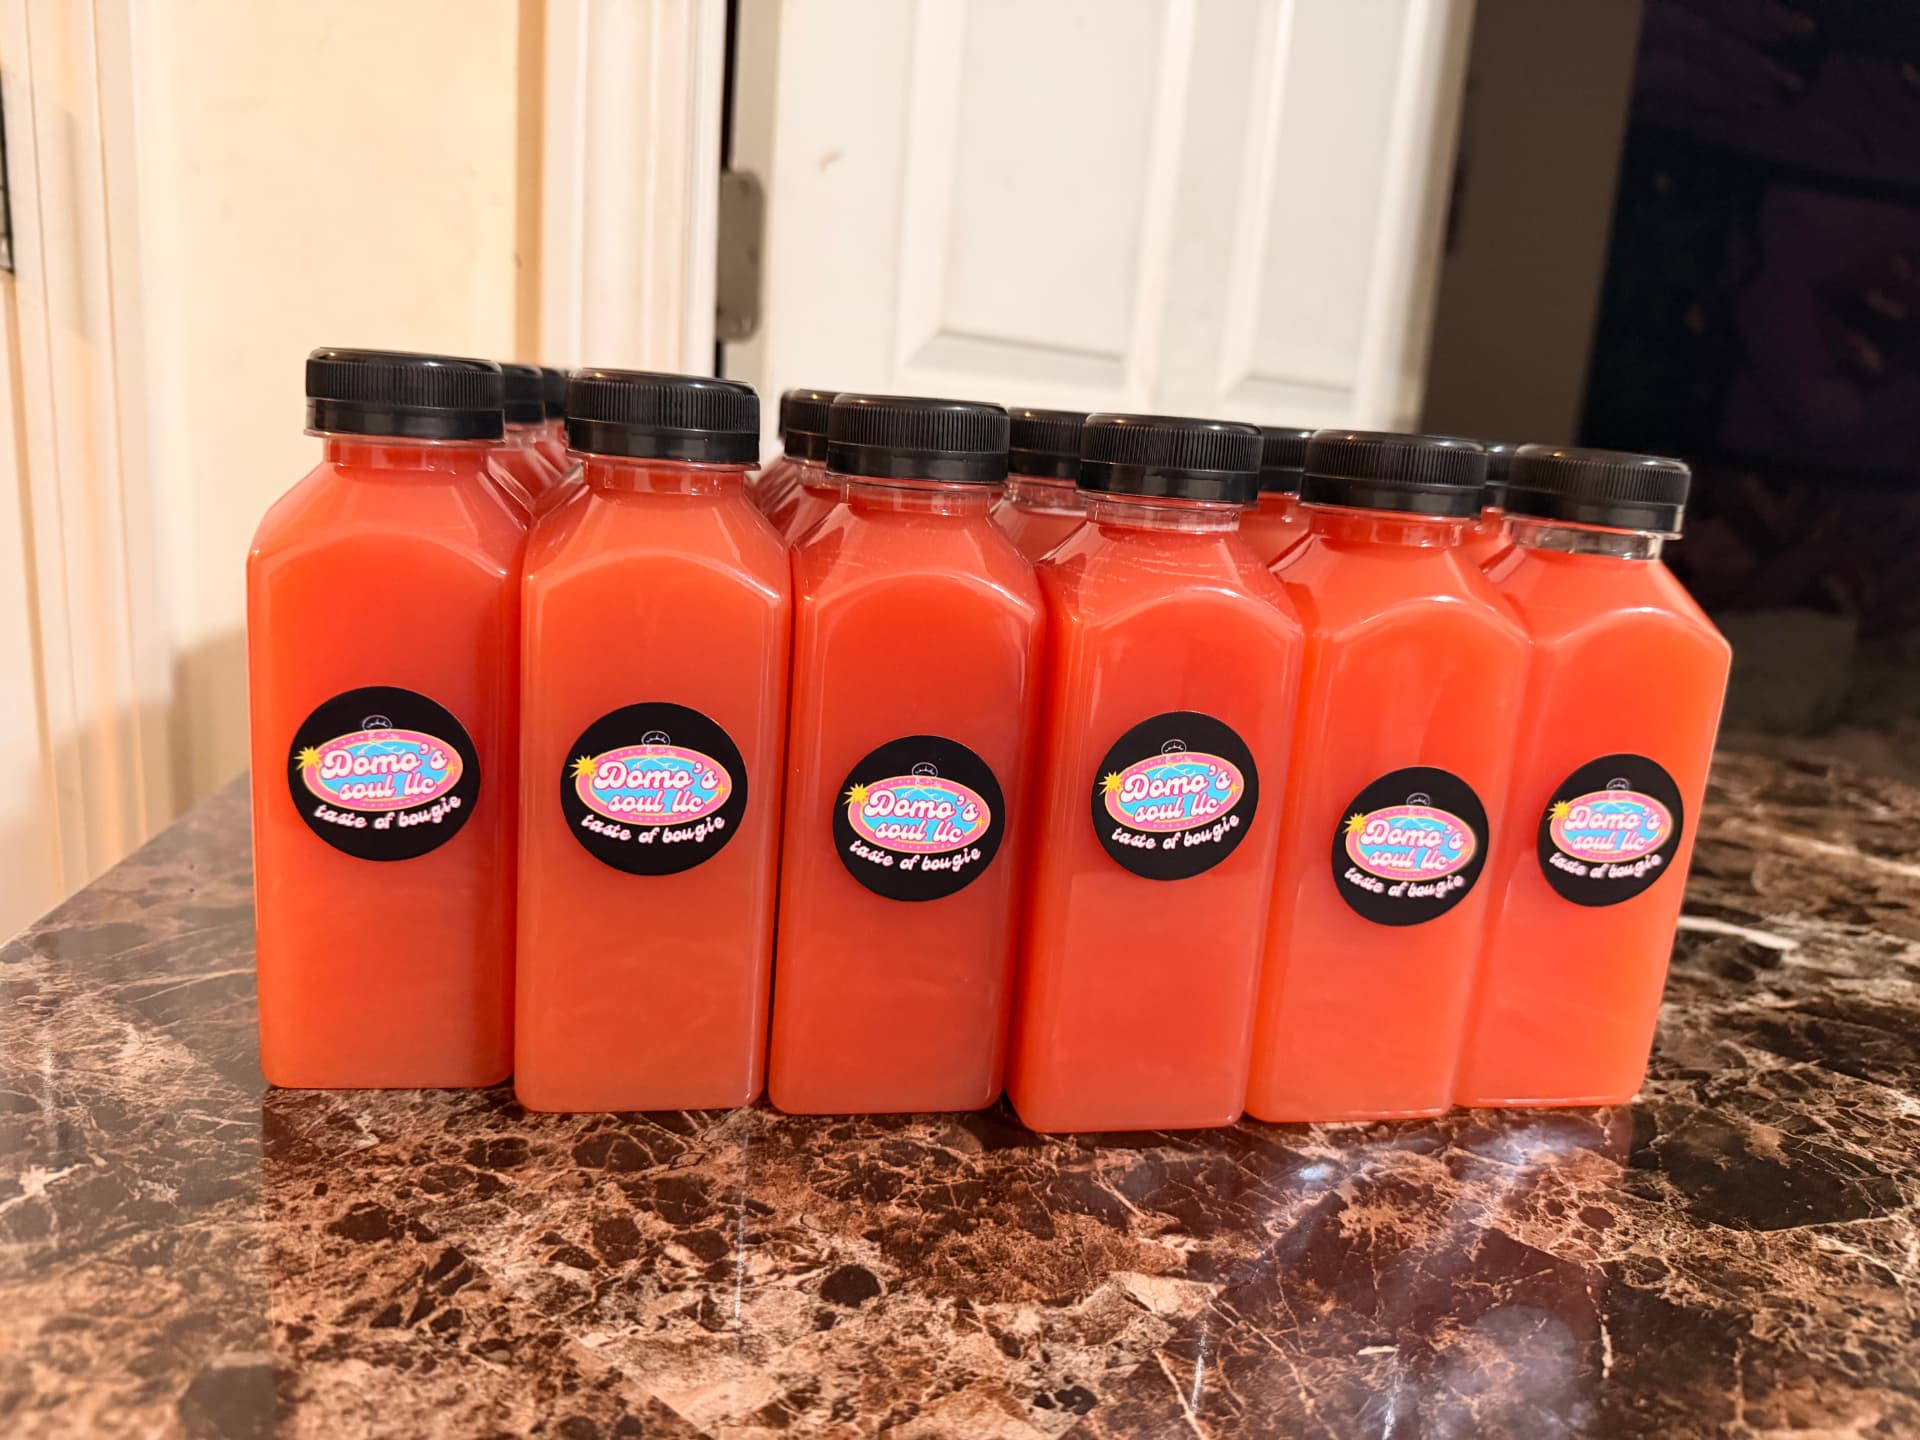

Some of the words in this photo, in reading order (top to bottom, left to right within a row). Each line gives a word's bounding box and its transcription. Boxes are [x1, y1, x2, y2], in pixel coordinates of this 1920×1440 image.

[320, 743, 448, 779] Domo's
[593, 760, 719, 790] Domo's
[338, 774, 396, 800] soul
[404, 773, 436, 796] llc
[1120, 765, 1232, 802] Domo's
[314, 804, 367, 828] taste
[374, 812, 394, 829] of
[398, 795, 461, 827] bougie
[608, 790, 665, 813] soul
[672, 790, 705, 813] llc
[864, 790, 979, 821] Domo's
[1134, 796, 1185, 822] soul
[1191, 794, 1219, 816] llc
[581, 814, 632, 841] taste
[638, 826, 660, 843] of
[662, 816, 725, 843] bougie
[875, 819, 928, 841] soul
[933, 821, 964, 843] llc
[1564, 805, 1661, 830] Domo's
[1112, 827, 1156, 849] taste
[1162, 832, 1181, 850] of
[1184, 815, 1239, 847] bougie
[1360, 819, 1465, 849] Domo's
[1572, 831, 1616, 850] soul
[1620, 831, 1647, 851] llc
[849, 840, 894, 866] taste
[899, 854, 920, 870] of
[921, 848, 981, 872] bougie
[1368, 849, 1416, 867] soul
[1420, 848, 1449, 870] llc
[1549, 852, 1587, 876] taste
[1590, 863, 1609, 878] of
[1608, 854, 1662, 878] bougie
[1344, 867, 1384, 893] taste
[1388, 881, 1408, 897] of
[1408, 875, 1464, 899] bougie
